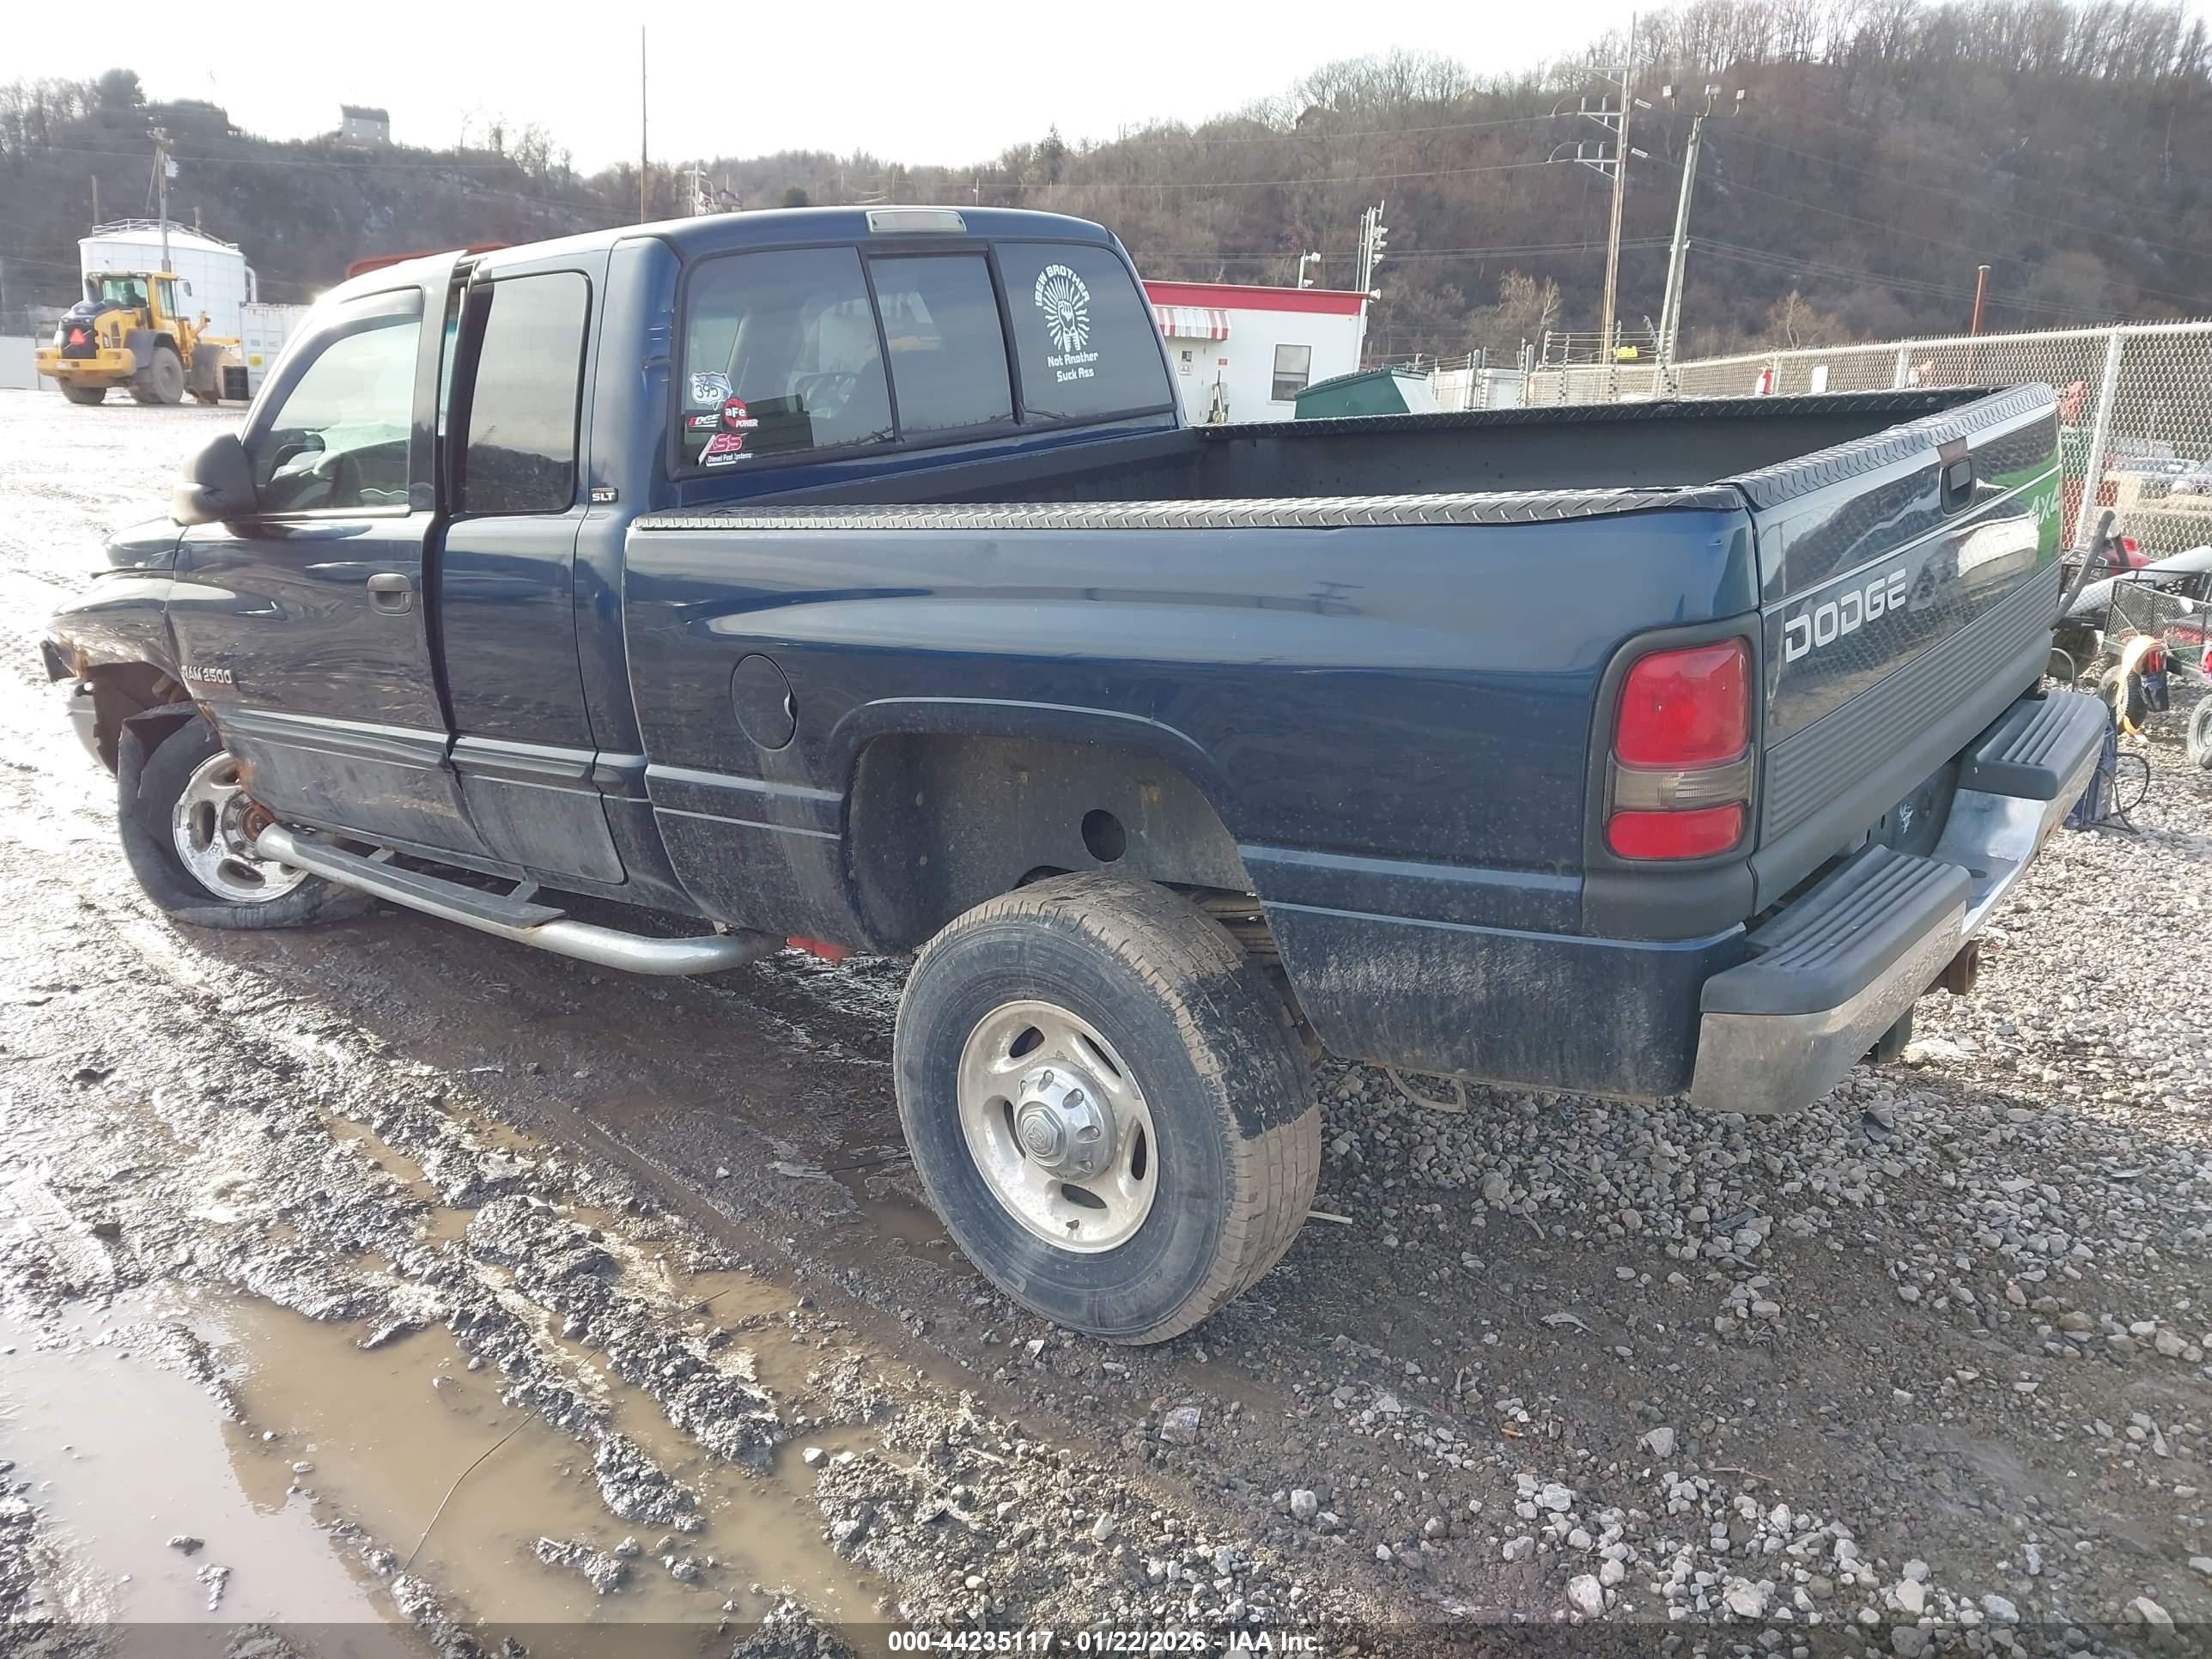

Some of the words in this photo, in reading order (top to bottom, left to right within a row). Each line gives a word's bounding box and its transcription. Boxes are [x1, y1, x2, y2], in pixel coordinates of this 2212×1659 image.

[1035, 270, 1048, 307] IBEW
[1045, 264, 1091, 302] BROTHER
[1047, 355, 1064, 368] Not
[1064, 351, 1099, 366] Another
[1056, 368, 1078, 383] Suck
[1078, 367, 1095, 379] Ass
[696, 384, 719, 399] 395
[725, 406, 746, 418] aFe
[735, 419, 758, 428] POWER
[708, 454, 722, 463] Diesel
[592, 492, 615, 501] SLT
[1784, 568, 1906, 664] DODGE
[180, 665, 203, 681] RAM
[203, 667, 233, 684] 2500
